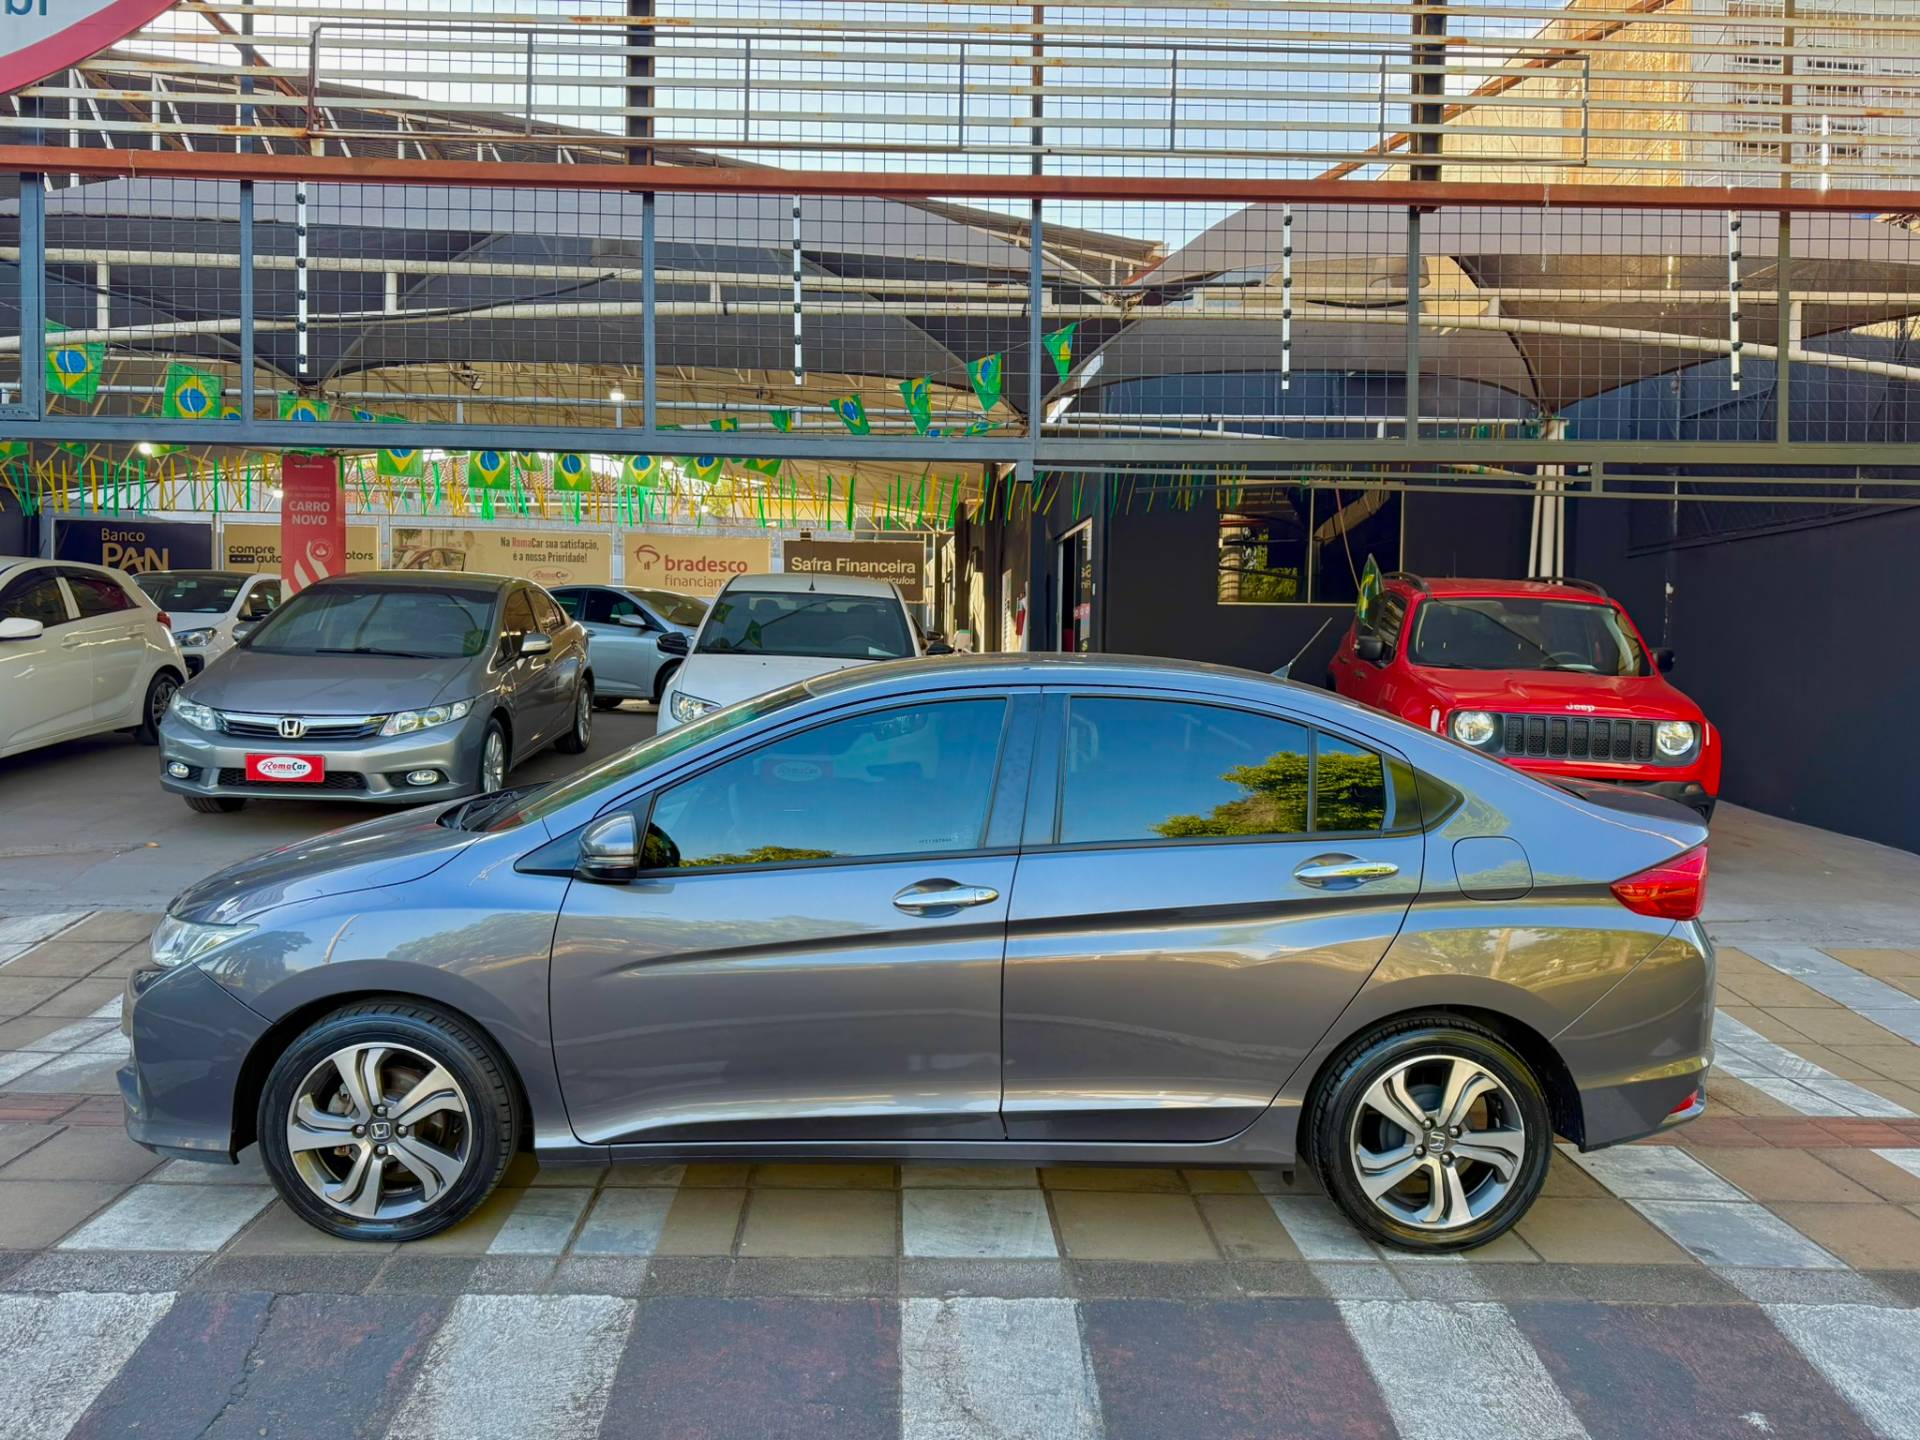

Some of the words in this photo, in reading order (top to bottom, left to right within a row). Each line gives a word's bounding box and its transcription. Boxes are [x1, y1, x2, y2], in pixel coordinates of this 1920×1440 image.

[289, 501, 330, 512] CARRO
[291, 514, 328, 525] NOVO
[101, 528, 145, 542] Banco
[500, 537, 511, 547] Na
[229, 545, 275, 557] compre
[344, 551, 374, 560] otors
[102, 543, 169, 572] PAN
[526, 554, 546, 562] nossa
[548, 552, 588, 563] Prioridade!
[665, 554, 748, 573] bradesco
[791, 557, 832, 571] Safra
[836, 558, 916, 574] Financeira
[665, 574, 726, 588] financiam
[1565, 702, 1596, 713] Jeep
[263, 761, 307, 771] RomaCar
